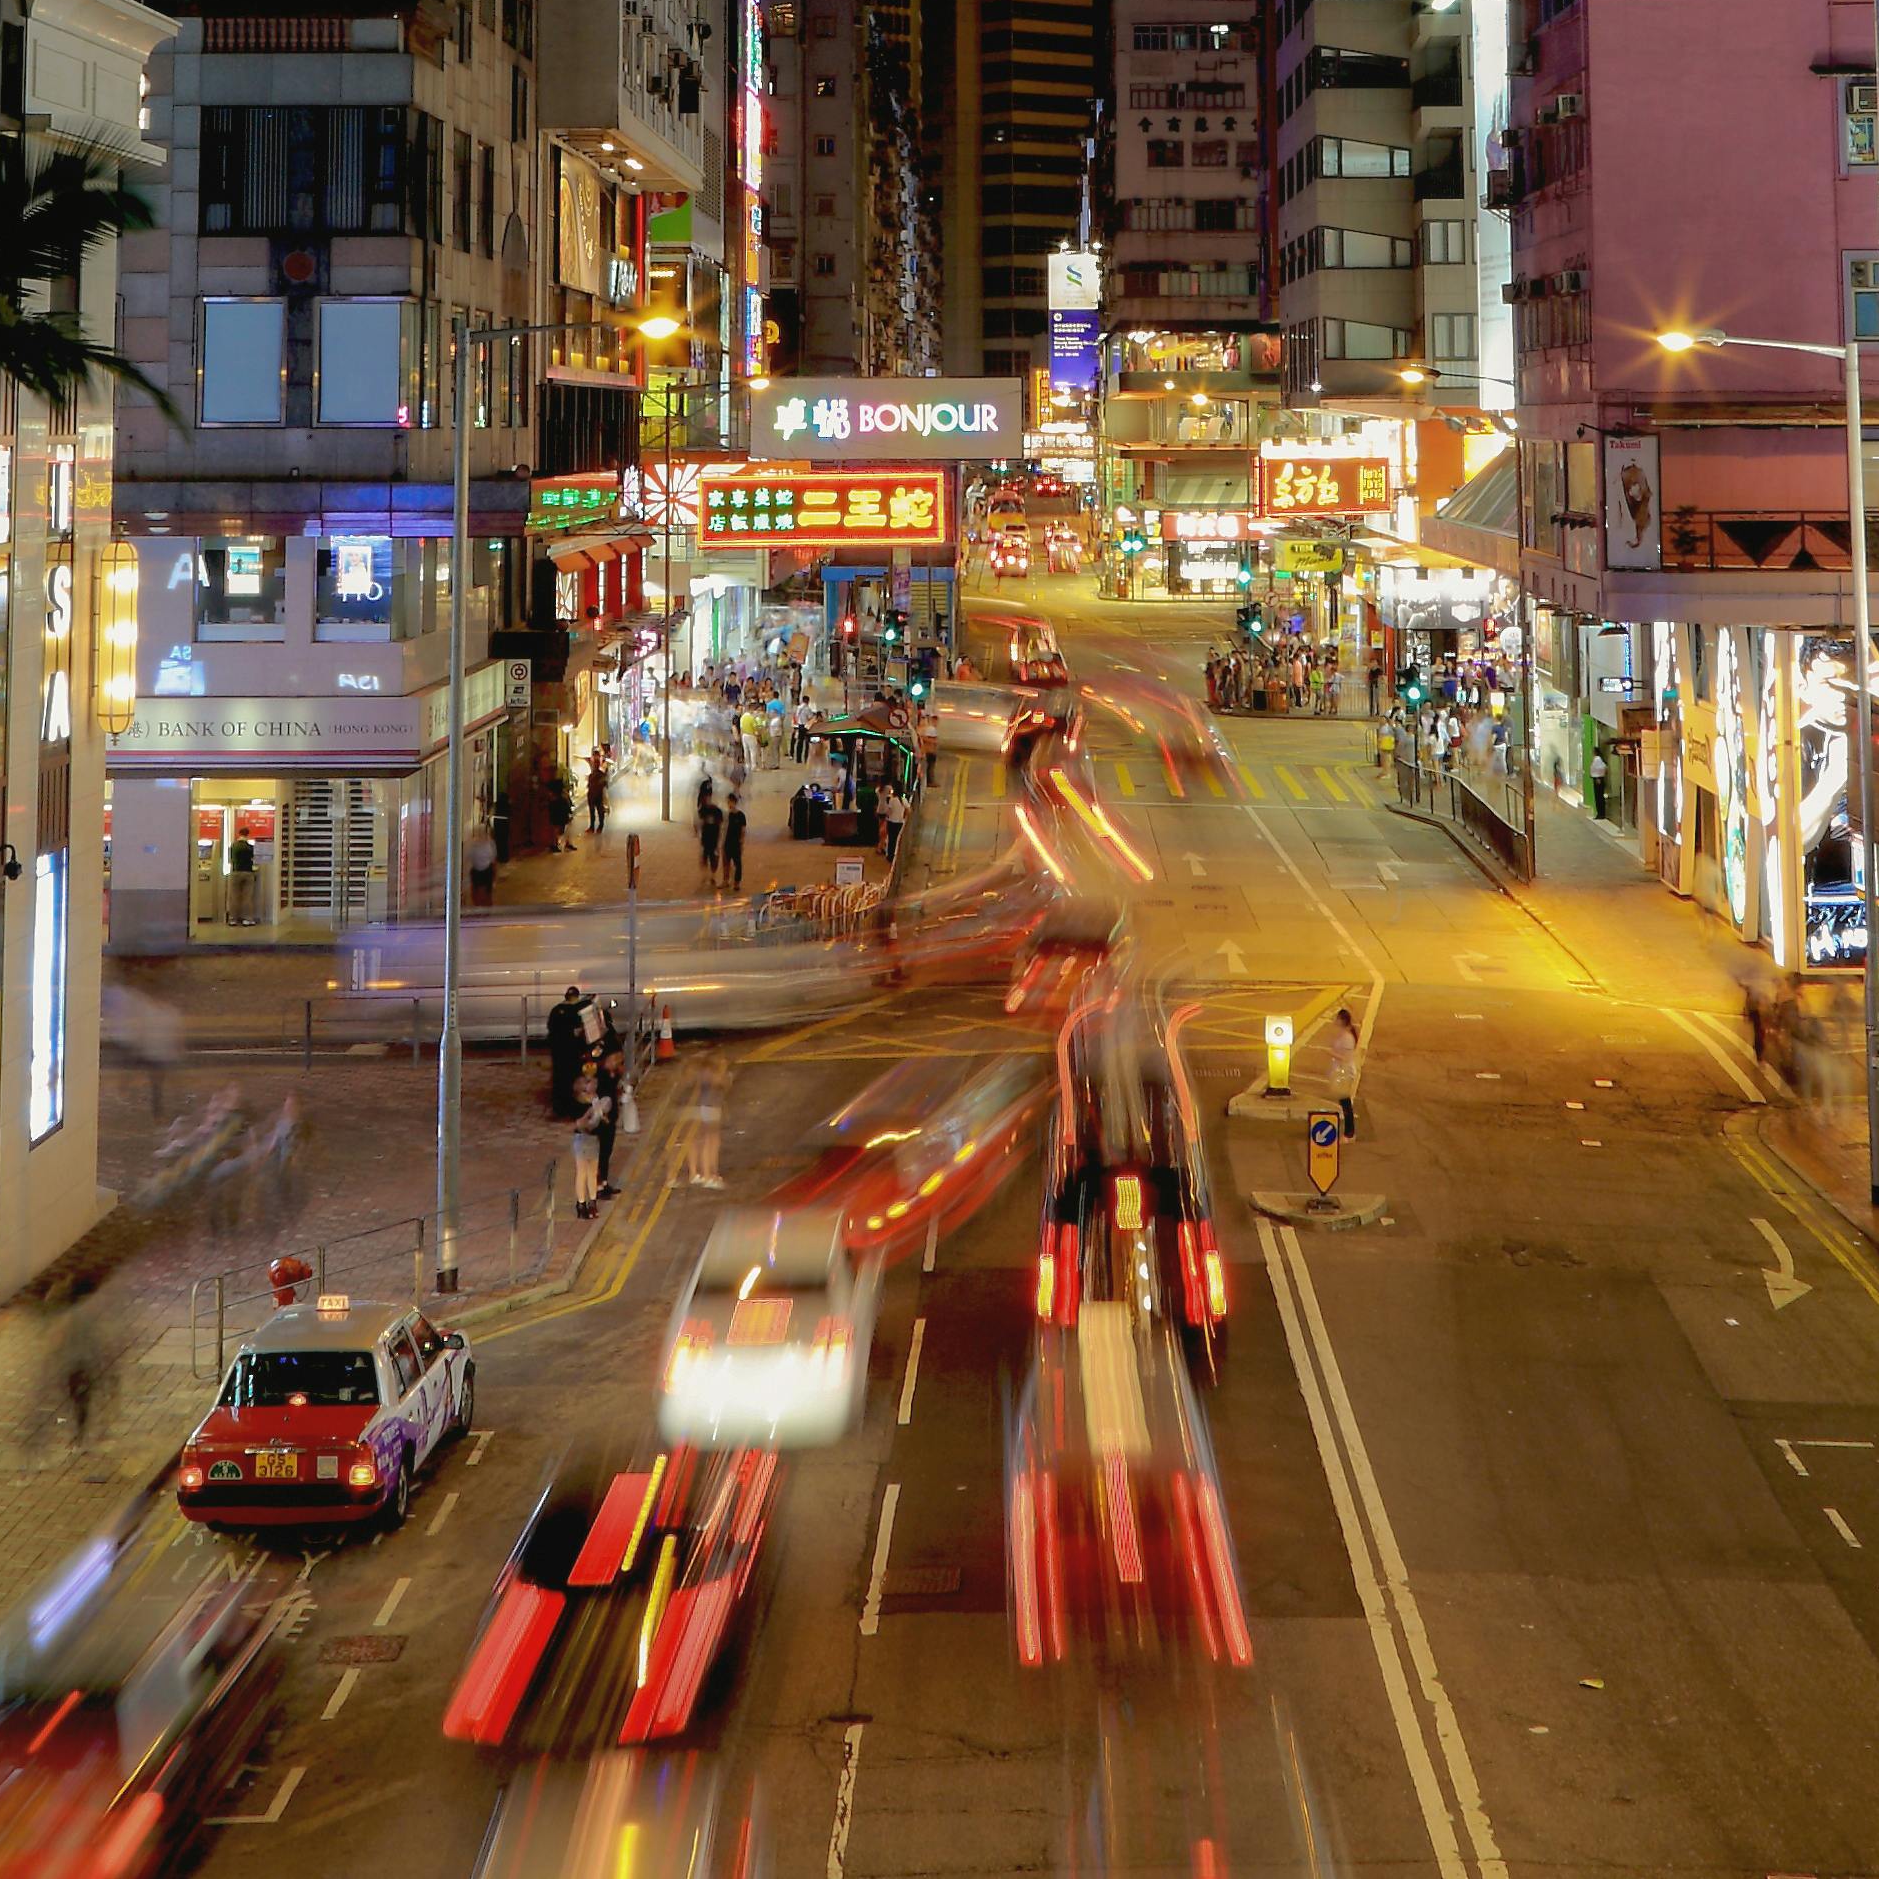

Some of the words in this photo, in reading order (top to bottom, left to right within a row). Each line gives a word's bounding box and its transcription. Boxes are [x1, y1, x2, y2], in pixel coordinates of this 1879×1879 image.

[859, 403, 999, 437] BONJOUR
[158, 722, 215, 737] BANK
[222, 722, 247, 737] OF
[254, 721, 322, 737] CHINA
[320, 1298, 347, 1309] TAXI
